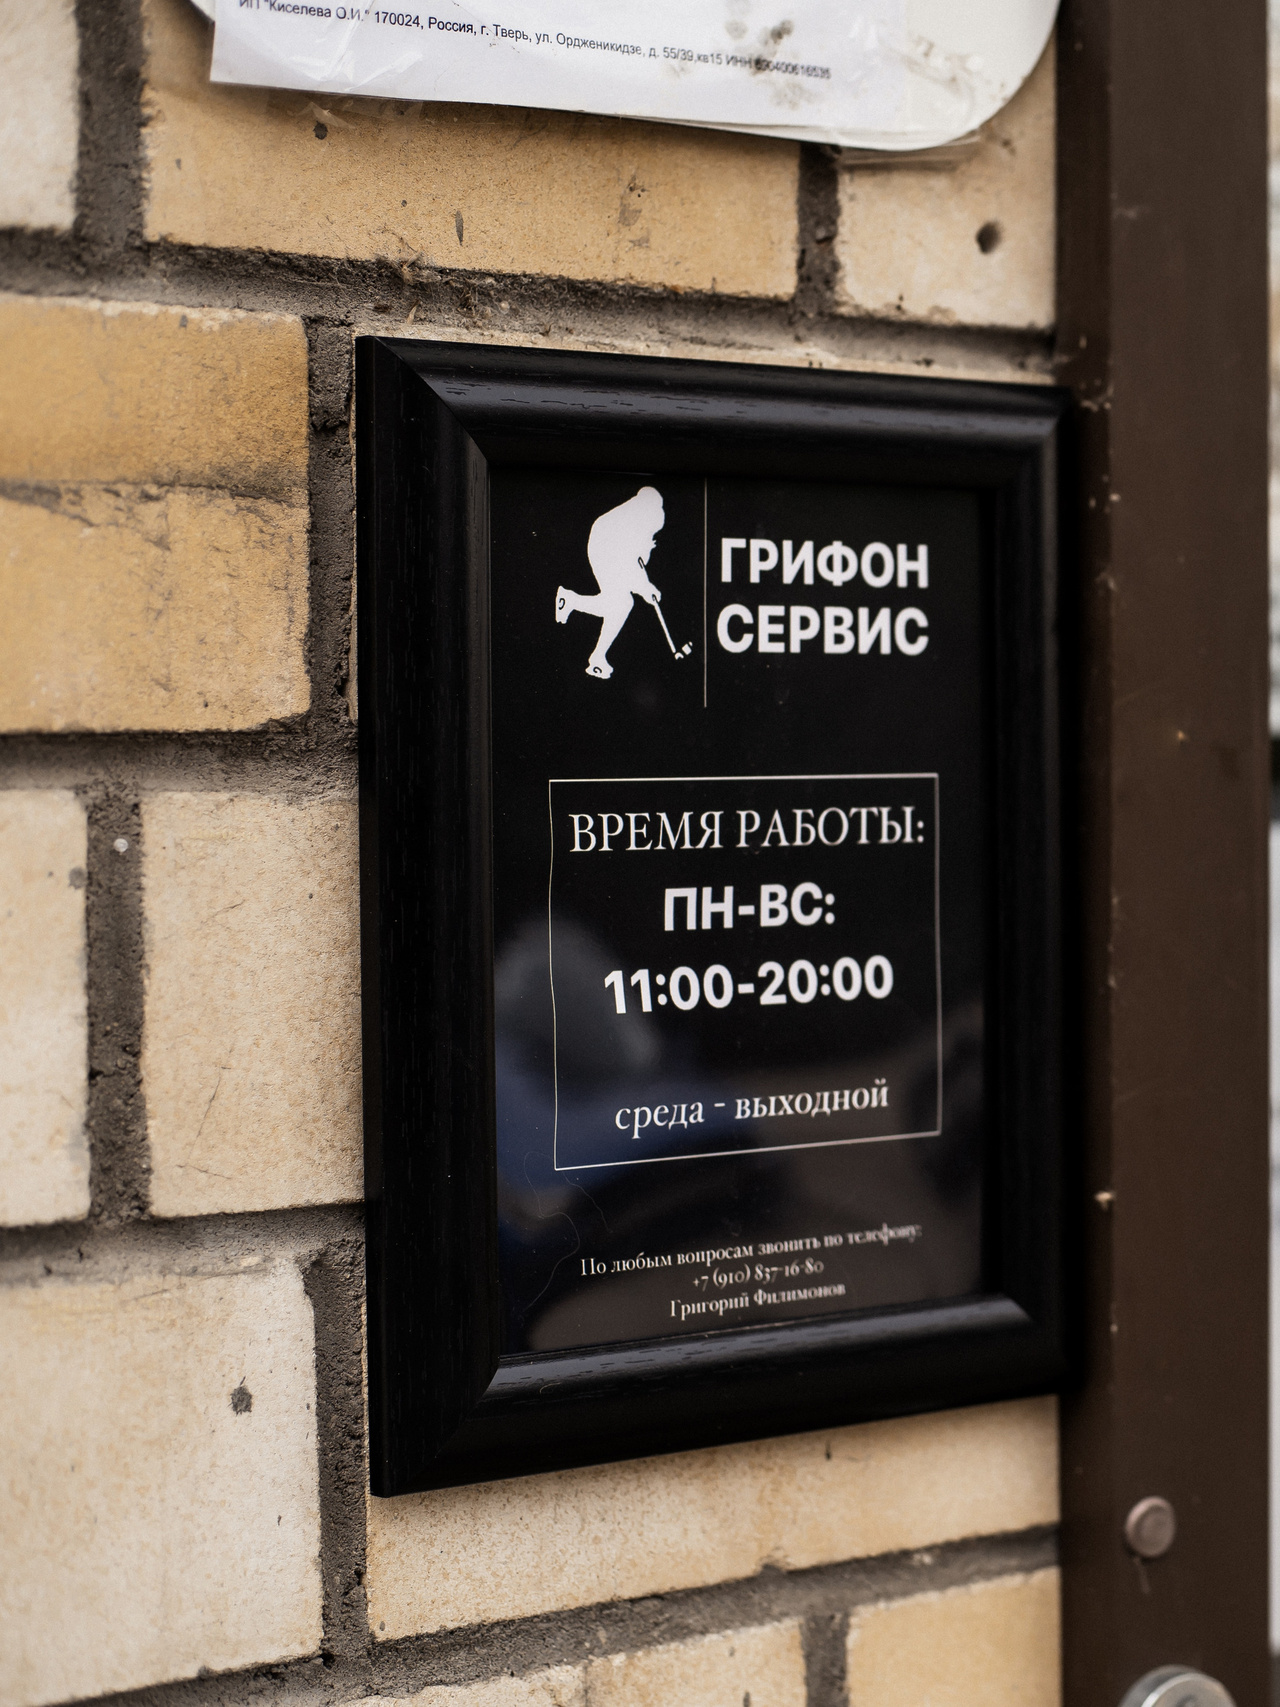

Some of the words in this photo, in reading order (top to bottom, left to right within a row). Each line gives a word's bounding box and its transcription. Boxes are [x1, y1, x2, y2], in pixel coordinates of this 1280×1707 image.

[374, 11, 424, 29] 170024,
[428, 17, 477, 36] Россия,
[481, 25, 489, 36] г.
[493, 24, 532, 43] Тверь,
[535, 32, 553, 46] ул.
[556, 33, 646, 58] Ордженикидзе,
[648, 47, 660, 60] д.
[721, 538, 929, 589] ГРИФОН
[717, 603, 929, 656] СЕРВИС
[568, 809, 725, 852] ВРЕМЯ
[735, 806, 925, 847] РАБОТЫ:
[664, 882, 836, 931] ПН-ВС:
[604, 955, 894, 1014] 11:00-20:00
[614, 1100, 705, 1139] среда
[735, 1078, 889, 1120] выходной
[581, 1257, 607, 1276] По
[611, 1252, 673, 1273] любым
[677, 1245, 754, 1267] вопросам
[757, 1237, 822, 1256] звонить
[823, 1233, 843, 1248] по
[846, 1222, 923, 1246] телефону:
[670, 1292, 750, 1321] Григорий
[753, 1283, 846, 1306] Филимонов
[692, 1275, 709, 1292] +7
[713, 1263, 751, 1289] (910)
